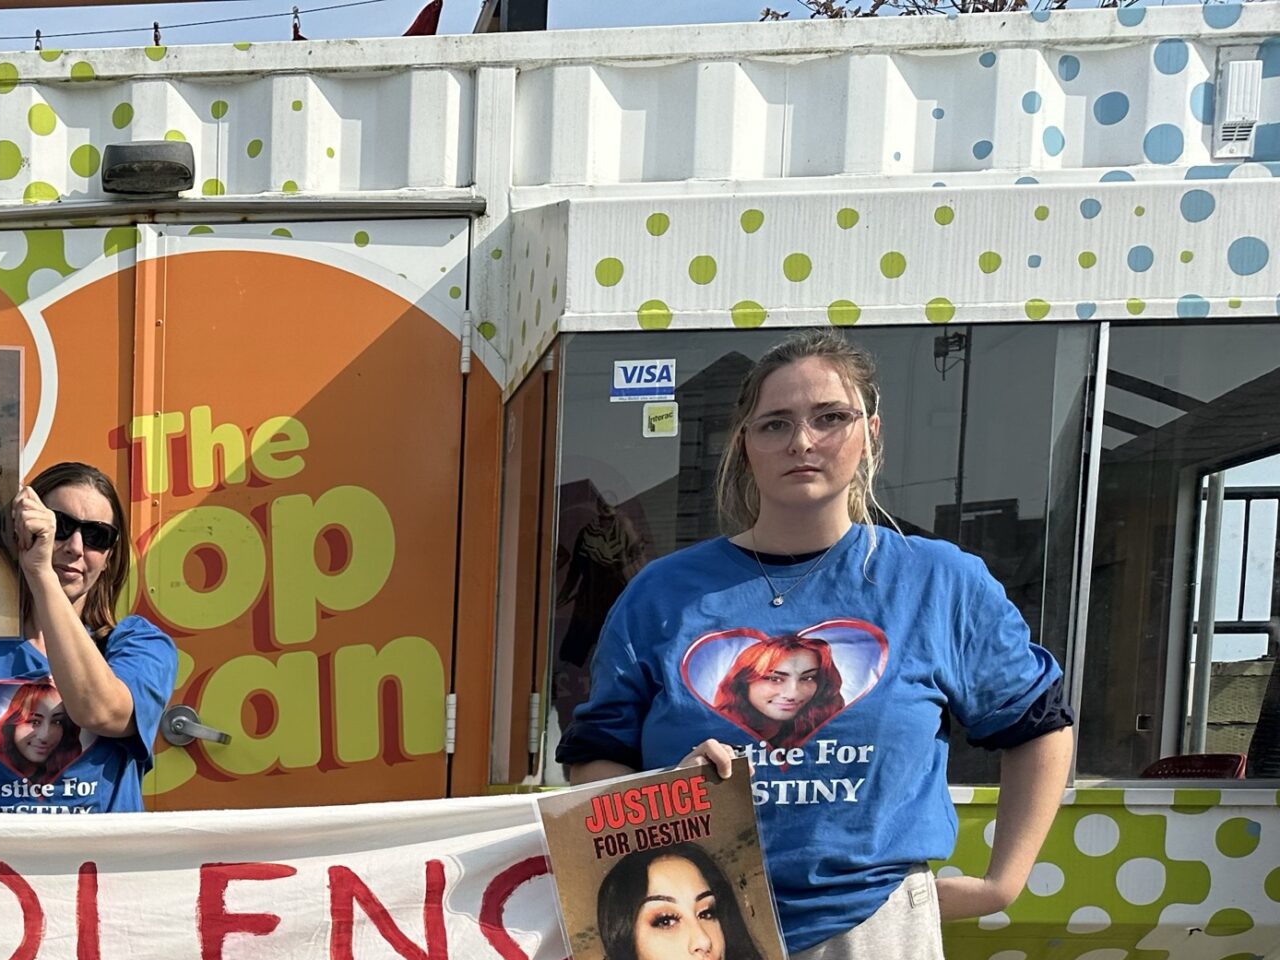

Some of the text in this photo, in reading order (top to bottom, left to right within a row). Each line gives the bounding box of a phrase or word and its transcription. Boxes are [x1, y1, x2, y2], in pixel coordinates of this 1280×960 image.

[618, 364, 673, 384] VISA
[648, 412, 674, 425] Interac
[128, 404, 310, 496] The
[116, 485, 396, 645] op
[815, 739, 874, 764] For
[62, 777, 98, 797] For
[751, 778, 866, 806] STINY
[585, 775, 712, 833] JUSTICE
[593, 814, 711, 859] FOR DESTINY
